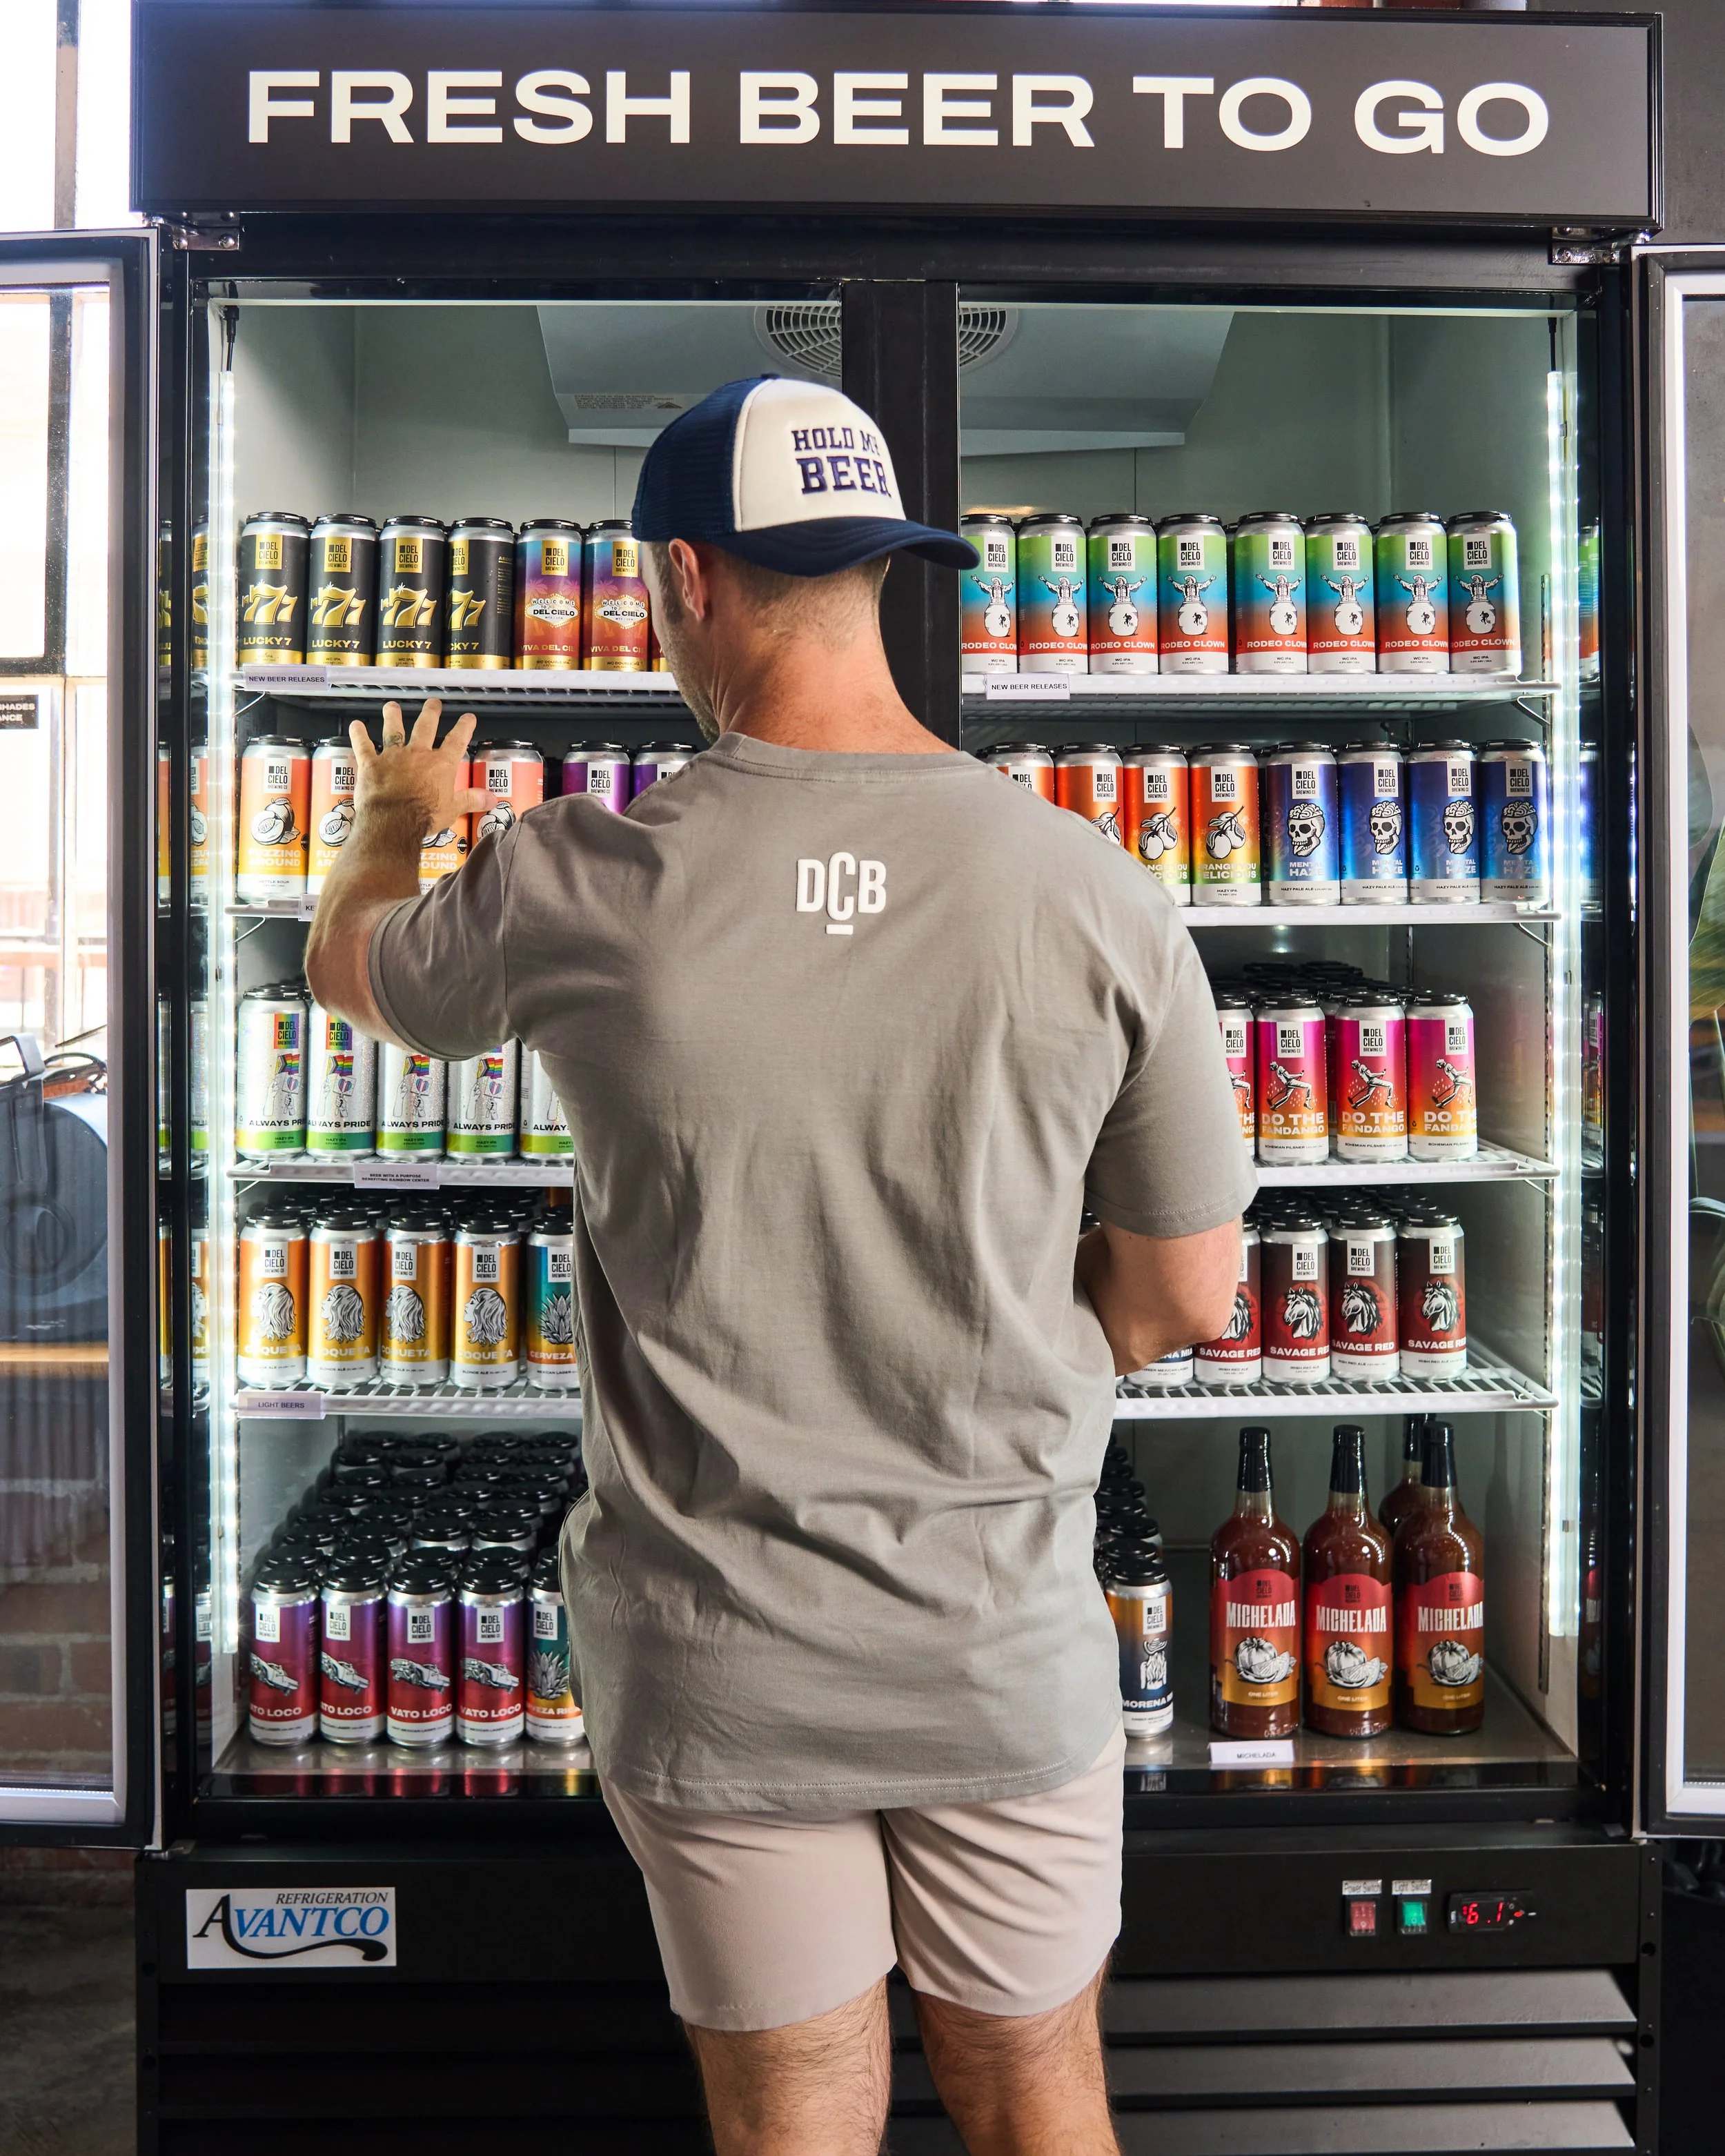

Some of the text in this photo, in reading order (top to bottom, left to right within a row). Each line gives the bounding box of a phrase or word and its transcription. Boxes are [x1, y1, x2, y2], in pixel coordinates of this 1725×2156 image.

[248, 70, 1549, 157] FRESH BEER TO GO
[791, 427, 880, 456] HOLD MY
[795, 455, 892, 499] BEER
[266, 542, 279, 551] DEL
[334, 544, 348, 553] DEL
[406, 545, 418, 554] DEL
[1062, 544, 1074, 553] DEL
[1118, 542, 1132, 551] DEL
[1187, 542, 1200, 551] DEL
[1474, 541, 1488, 550] DEL
[259, 551, 279, 560] CIELO
[328, 553, 348, 562] CIELO
[399, 554, 419, 564] CIELO
[1055, 552, 1074, 562] CIELO
[1112, 551, 1132, 562] CIELO
[1181, 551, 1201, 560] CIELO
[1466, 550, 1488, 560] CIELO
[531, 597, 575, 606] WELCOME
[602, 598, 646, 609] WELCOME
[551, 609, 575, 617] CIELO
[243, 636, 293, 646] LUCKY 7
[311, 639, 361, 649] LUCKY 7
[382, 640, 432, 649] LUCKY 7
[1029, 641, 1065, 650] RODEO
[1091, 640, 1155, 650] RODEO CLOWN
[1161, 640, 1225, 649] RODEO CLOWN
[1385, 640, 1420, 649] RODEO
[1450, 638, 1516, 649] RODEO CLOWN
[275, 765, 288, 775] DEL
[495, 769, 509, 778] DEL
[1457, 769, 1469, 778] DEL
[268, 775, 288, 784] CIELO
[1154, 774, 1167, 784] DEL
[1221, 773, 1235, 782] DEL
[1303, 771, 1316, 780] DEL
[489, 778, 509, 789] CIELO
[1214, 782, 1236, 792] CIELO
[1295, 780, 1316, 790] CIELO
[1451, 777, 1469, 787] CIELO
[1147, 784, 1167, 793] CIELO
[247, 849, 302, 859] FUZZING
[248, 858, 301, 867] AROUND
[1238, 862, 1256, 871] YOU
[1372, 858, 1403, 867] MENTAL
[1196, 869, 1256, 880] DELICIOUS
[1289, 867, 1324, 877] HAZE
[1372, 865, 1403, 876] HAZE
[1446, 864, 1477, 875] HAZE
[795, 851, 887, 921] DCB
[285, 1021, 297, 1030] DEL
[277, 1030, 297, 1040] CIELO
[1288, 1029, 1301, 1038] DEL
[1370, 1028, 1383, 1037] DEL
[1281, 1038, 1301, 1048] CIELO
[1363, 1037, 1383, 1047] CIELO
[1261, 1111, 1325, 1126] DO THE
[1342, 1110, 1404, 1124] DO THE
[343, 1120, 371, 1128] PRIDE
[421, 1119, 444, 1128] PRIDE
[453, 1122, 492, 1131] ALWAYS
[1261, 1124, 1325, 1135] FANDANGO
[1342, 1124, 1404, 1134] FANDANGO
[1357, 1248, 1370, 1257] DEL
[484, 1254, 496, 1263] DEL
[1350, 1256, 1370, 1267] CIELO
[476, 1263, 497, 1273] CIELO
[1331, 1338, 1394, 1353] SAVAGE RED
[457, 1349, 513, 1361] COQUETA
[530, 1351, 574, 1360] CERVEZA
[1199, 1346, 1261, 1358] SAVAGE RED
[488, 1614, 500, 1623] DEL
[1226, 1600, 1297, 1628] MICHELADA
[1316, 1605, 1387, 1633] MICHELADA
[1417, 1600, 1483, 1633] MICHELADA
[481, 1623, 501, 1633] CIELO
[1122, 1698, 1167, 1710] MORENA
[337, 1705, 373, 1716] LOCO
[391, 1703, 453, 1719] VATO LOCO
[1236, 1751, 1276, 1759] MICHELADA
[275, 1892, 389, 1905] REFRIGERATION
[192, 1893, 390, 1945] AVANTCO
